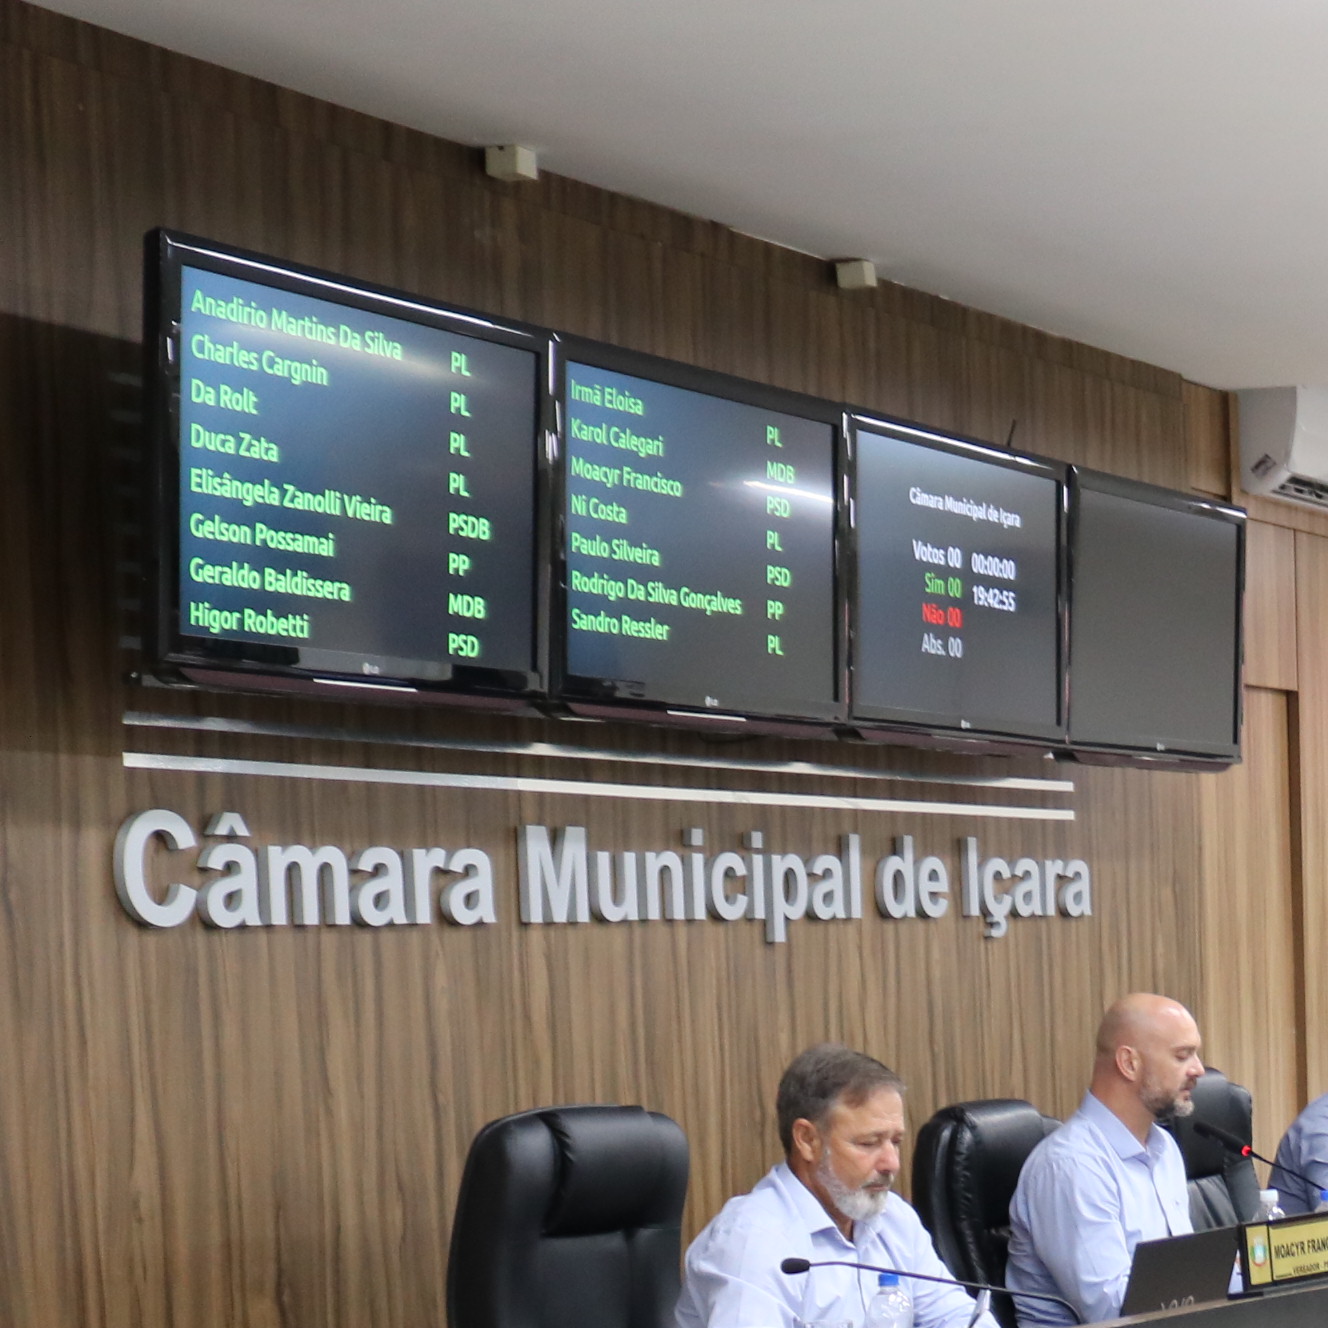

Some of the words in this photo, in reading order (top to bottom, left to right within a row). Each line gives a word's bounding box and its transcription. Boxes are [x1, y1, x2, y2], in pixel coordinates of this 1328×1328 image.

[190, 290, 266, 330] Anadirio
[271, 310, 336, 345] Martins
[339, 328, 362, 351] Da
[365, 332, 403, 361] Silva
[451, 352, 472, 377] PL
[191, 335, 259, 372] Charles
[261, 353, 330, 387] Cargnin
[450, 392, 471, 417] PL
[190, 379, 217, 406] Da
[219, 385, 259, 415] Rolt
[450, 432, 471, 457] PL
[571, 379, 602, 404] Irmã
[604, 388, 645, 416] Eloisa
[766, 425, 784, 448] PL
[190, 423, 235, 454] Duca
[238, 433, 280, 463] Zata
[449, 473, 470, 498] PL
[571, 418, 608, 445] Karol
[610, 427, 665, 458] Calegari
[766, 461, 796, 485] MDB
[190, 468, 281, 508] Elisângela
[283, 484, 342, 517] Zanolli
[344, 494, 393, 525] Vieira
[448, 512, 492, 541] PSDB
[571, 456, 621, 489] Moacyr
[623, 467, 683, 498] Francisco
[766, 495, 791, 519] PSD
[909, 487, 945, 511] Câmara
[945, 495, 988, 522] Municipal
[988, 504, 1000, 523] de
[1000, 507, 1022, 528] Içara
[189, 512, 252, 544] Gelson
[255, 523, 336, 557] Possamai
[448, 553, 472, 577] PP
[571, 494, 588, 518] Ni
[589, 501, 629, 525] Costa
[767, 530, 784, 552] PL
[571, 532, 609, 558] Paulo
[611, 539, 661, 567] Silveira
[767, 565, 793, 588] PSD
[912, 539, 946, 566] Votos
[947, 546, 962, 569] 00
[971, 553, 1017, 580] 00:00:00
[189, 557, 261, 591] Geraldo
[264, 567, 352, 602] Baldissera
[448, 593, 487, 621] MDB
[571, 570, 625, 601] Rodrigo
[627, 579, 645, 600] Da
[647, 580, 678, 605] Silva
[680, 587, 743, 615] Gonçalves
[767, 600, 785, 621] PP
[924, 572, 946, 596] Sim
[947, 577, 963, 598] 00
[972, 585, 1017, 612] 19:42:55
[189, 602, 241, 637] Higor
[244, 609, 310, 639] Robetti
[448, 633, 479, 658] PSD
[571, 608, 619, 634] Sandro
[622, 616, 671, 642] Ressler
[767, 635, 785, 656] PL
[922, 602, 946, 625] Não
[947, 607, 963, 629] 00
[921, 633, 946, 656] Abs.
[948, 636, 963, 659] 00
[113, 809, 496, 929] Câmara
[517, 824, 861, 944] Municipal
[875, 835, 948, 919] de
[960, 836, 1092, 938] Içara
[1273, 1240, 1306, 1259] MOACYR
